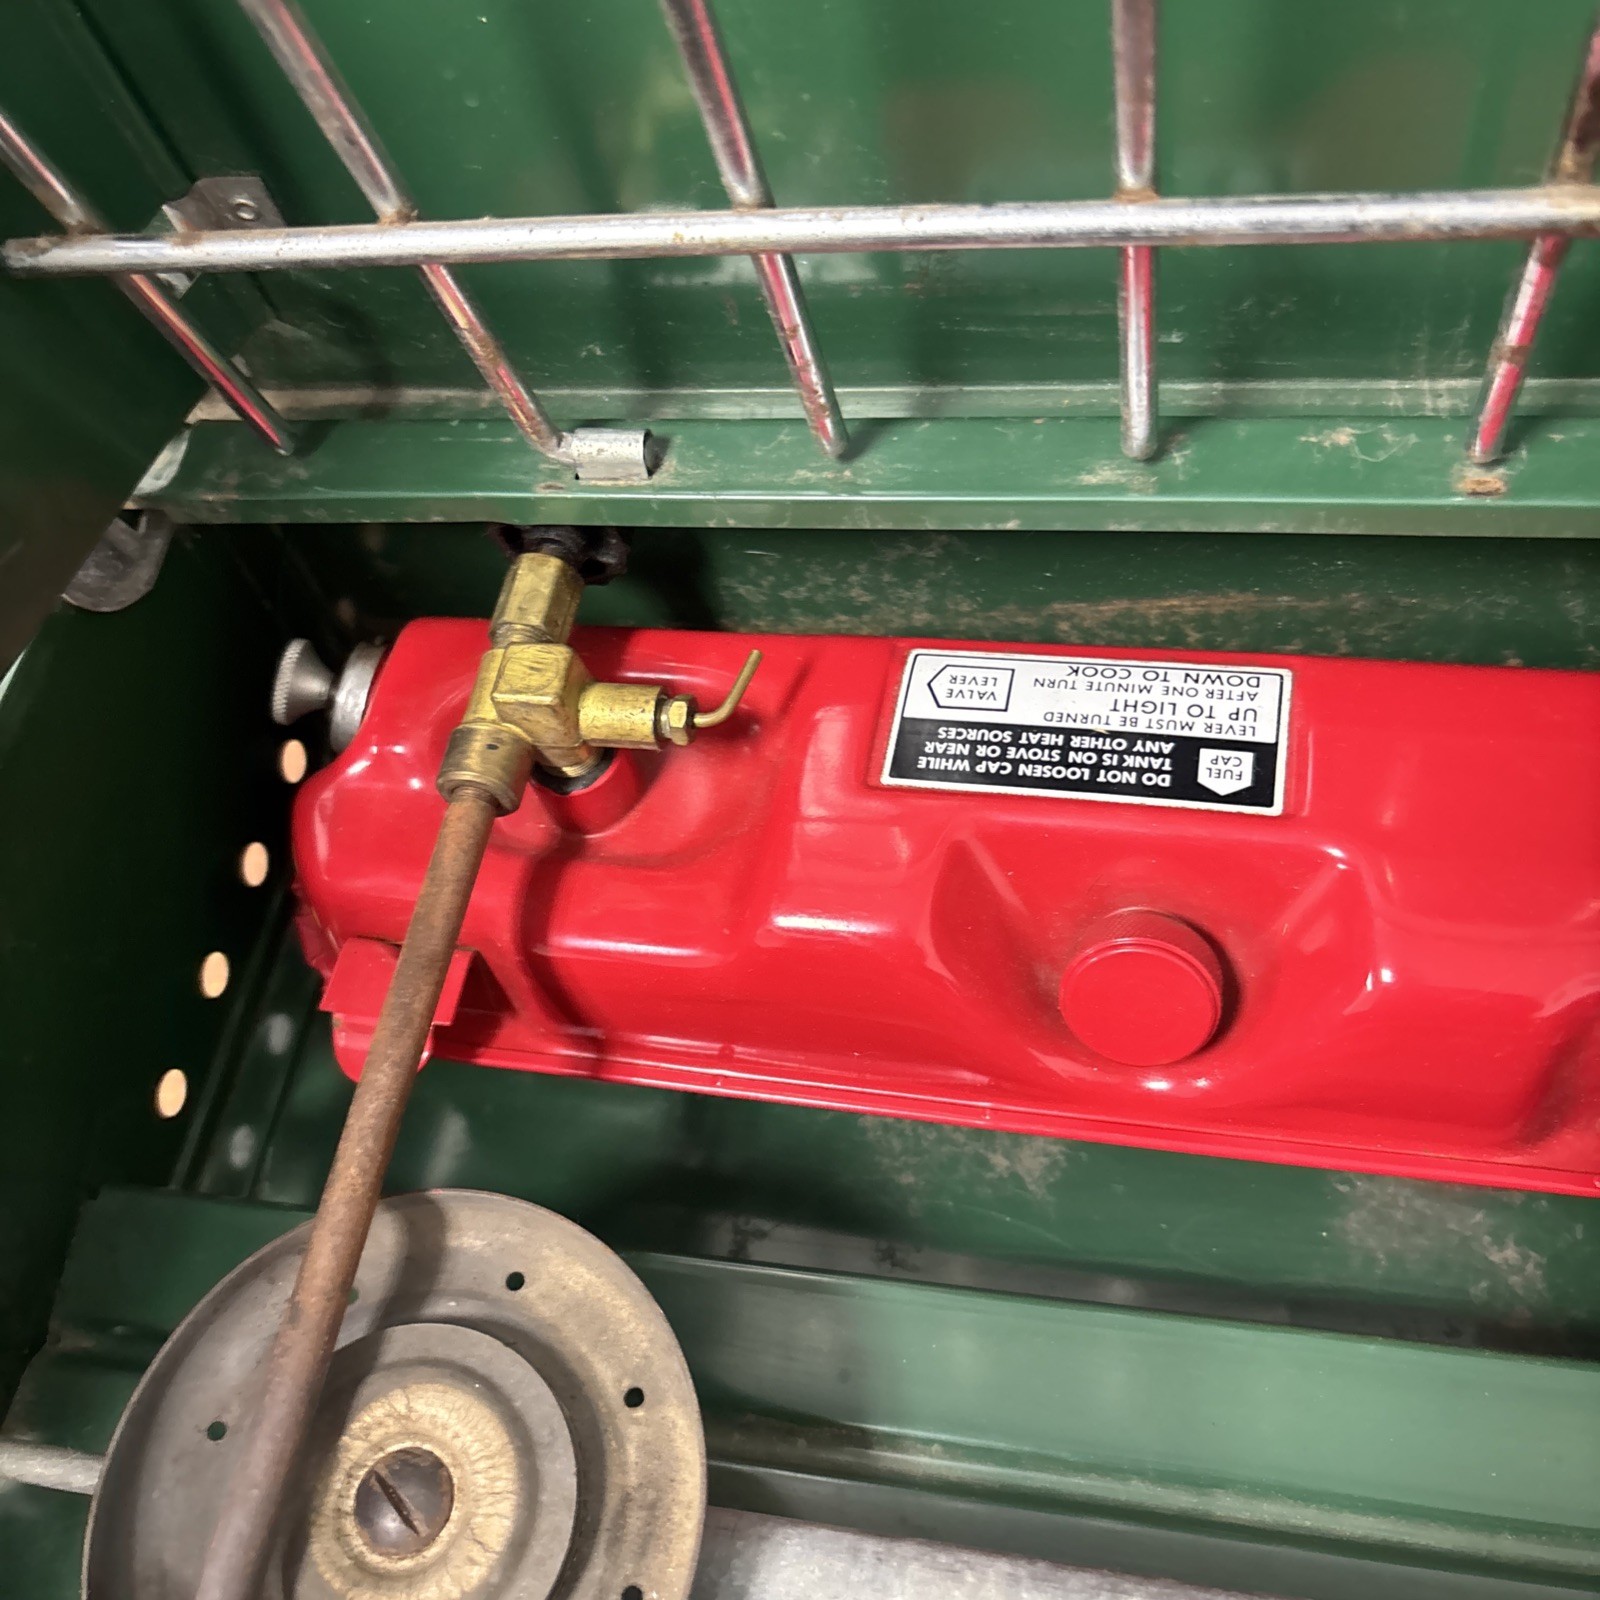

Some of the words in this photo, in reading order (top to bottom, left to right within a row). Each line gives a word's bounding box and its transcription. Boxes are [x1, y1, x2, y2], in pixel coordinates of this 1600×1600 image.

[1067, 666, 1131, 680] COOK
[1142, 670, 1170, 683] TO
[1184, 672, 1260, 687] DOWN
[949, 674, 998, 687] LEVER
[1033, 678, 1078, 690] TURN
[1085, 680, 1153, 694] MINUTE
[946, 688, 998, 701] VALVE
[1162, 685, 1199, 697] ONE
[1206, 689, 1259, 702] AFTER
[1110, 698, 1177, 716] LIGHT
[1187, 704, 1215, 718] TO
[1043, 711, 1111, 726] TURNED
[1229, 707, 1258, 722] UP
[1120, 716, 1139, 728] BE
[1146, 718, 1195, 731] MUST
[1203, 722, 1256, 736] LEVER
[937, 726, 1012, 743] SOURCES
[1018, 731, 1064, 746] HEAT
[924, 741, 970, 756] NEAR
[1070, 735, 1128, 752] OTHER
[1132, 739, 1174, 754] ANY
[976, 744, 1001, 759] OR
[1006, 745, 1061, 763] STOVE
[1069, 751, 1098, 765] ON
[917, 756, 971, 772] WHILE
[1102, 753, 1118, 767] IS
[1123, 754, 1172, 770] TANK
[1210, 755, 1242, 767] CAP
[975, 760, 1012, 775] CAP
[1018, 763, 1091, 780] LOOSEN
[1206, 767, 1243, 781] FUEL
[1096, 769, 1137, 784] NOT
[1141, 772, 1171, 786] DO
